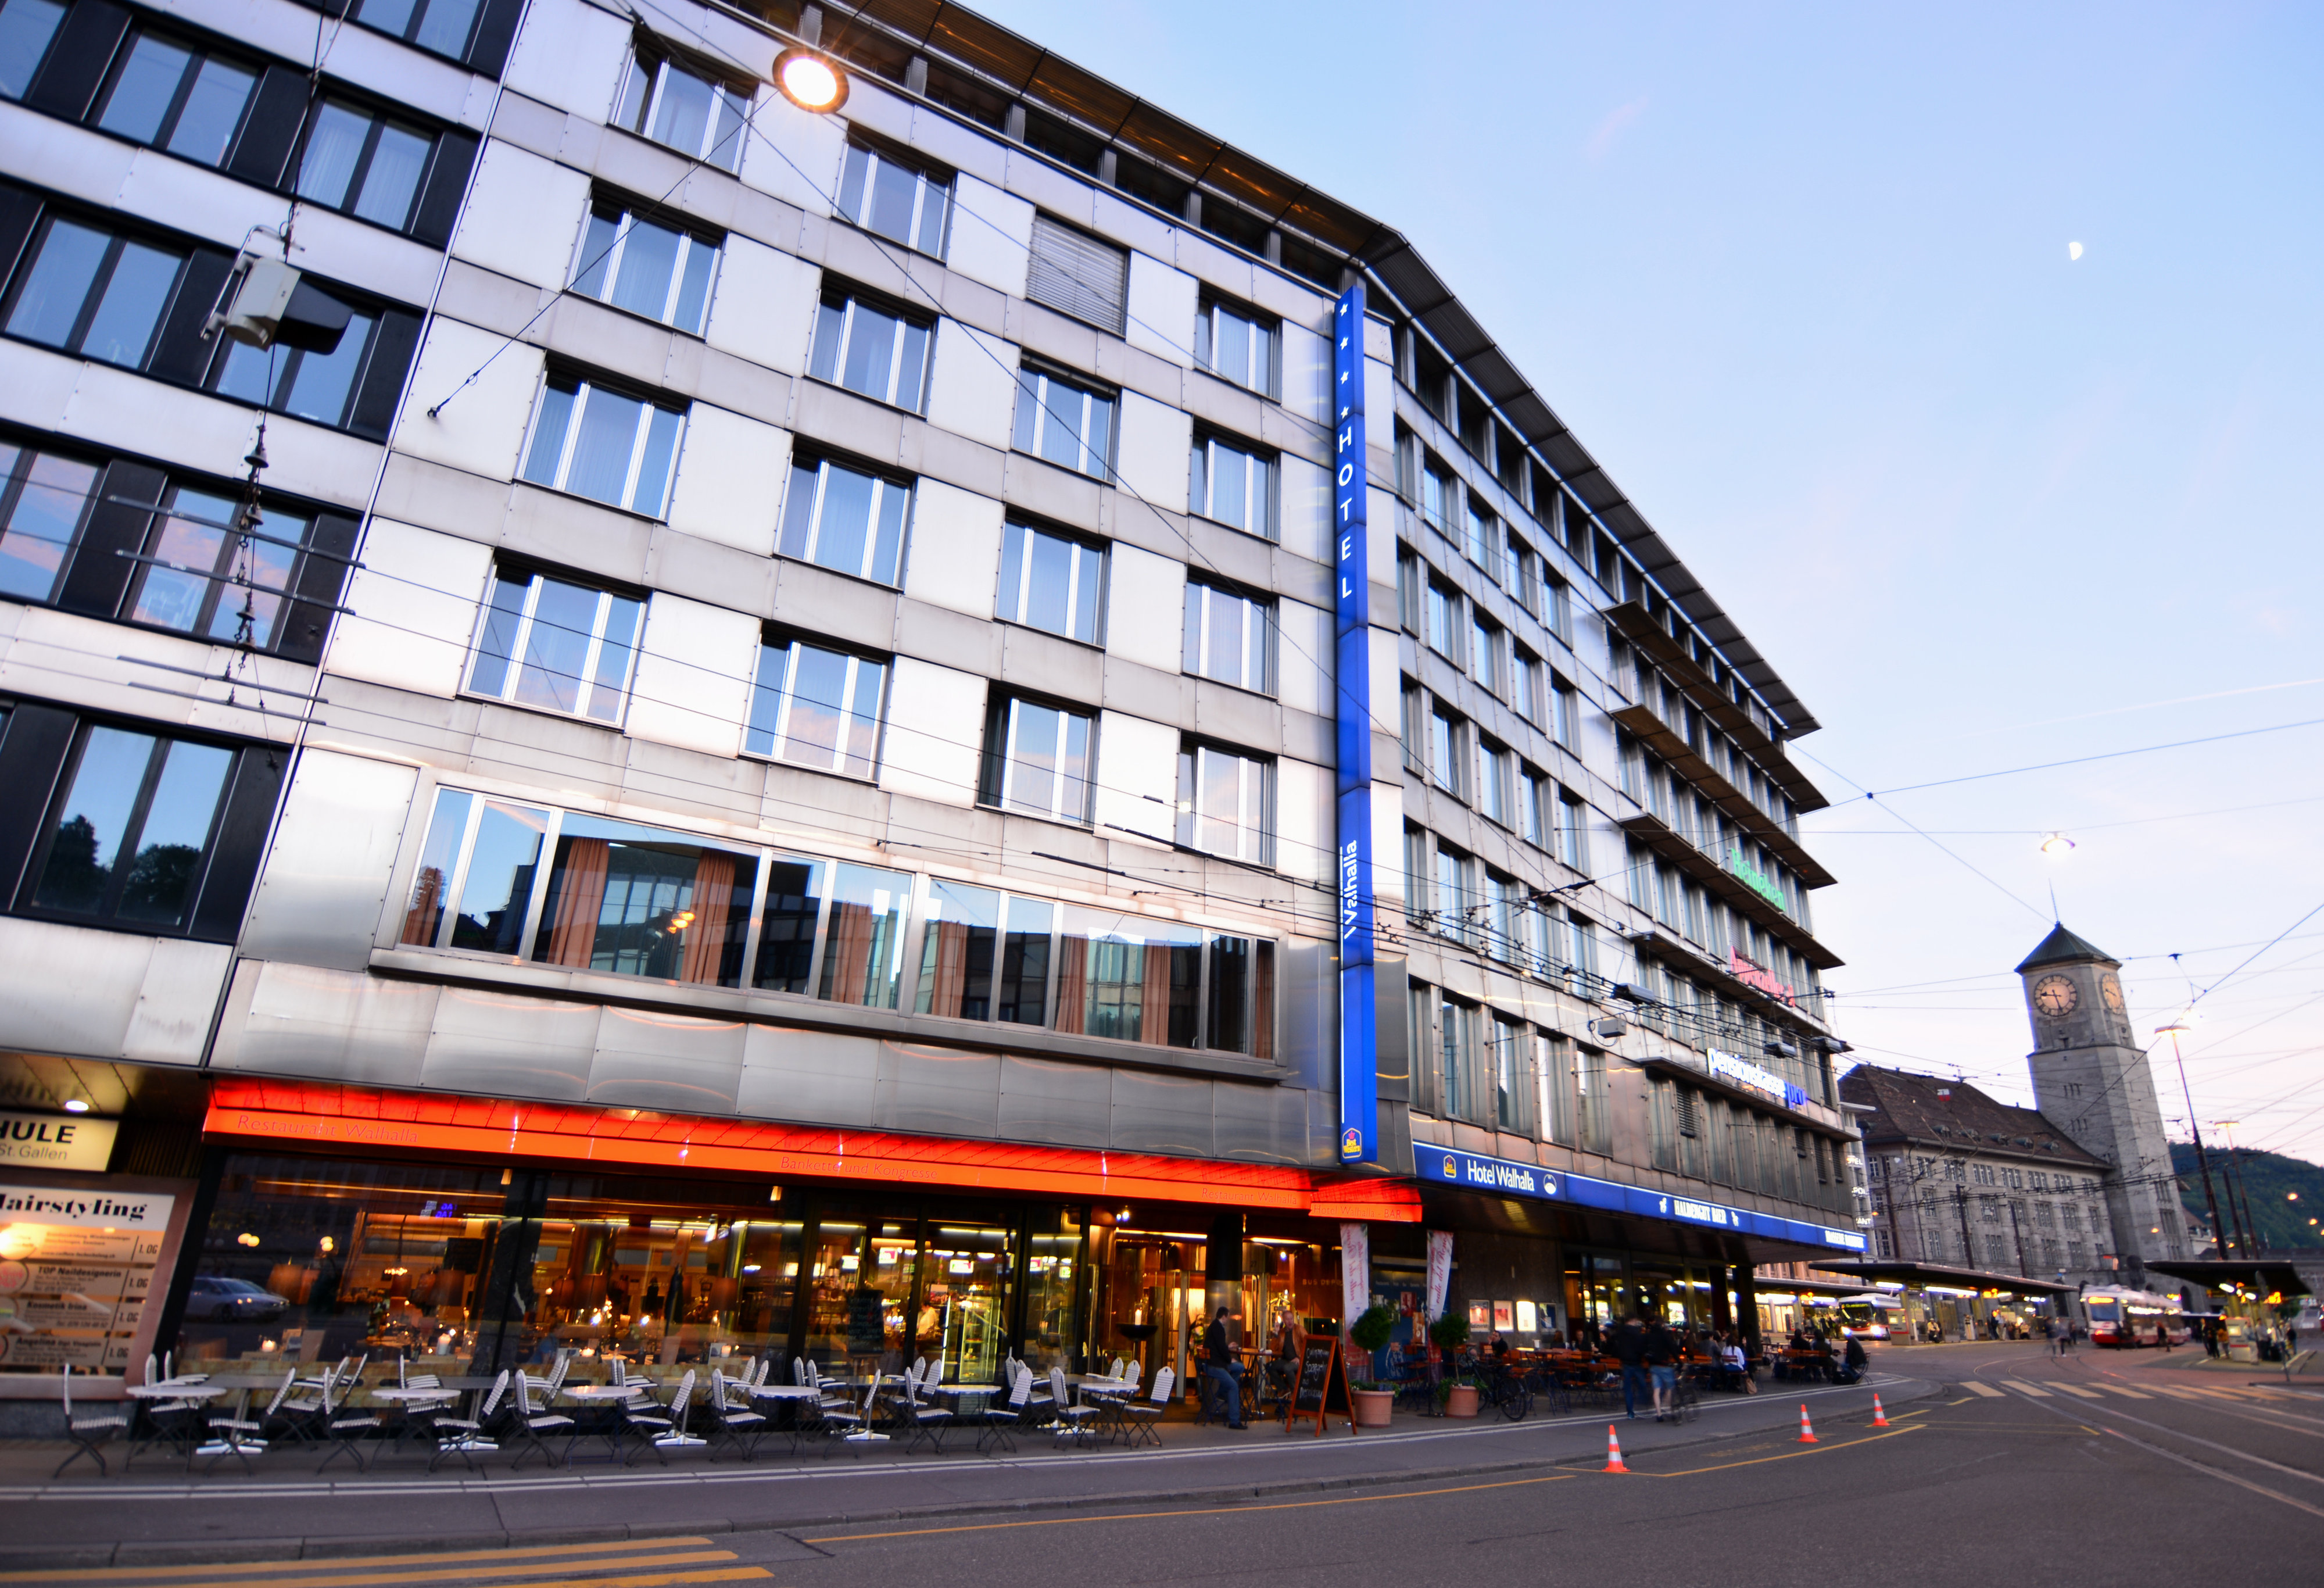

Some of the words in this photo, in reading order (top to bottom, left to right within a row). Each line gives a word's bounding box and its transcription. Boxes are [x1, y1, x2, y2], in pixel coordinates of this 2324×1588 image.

[1339, 425, 1352, 599] HOTEL
[1731, 848, 1785, 911] Heineken
[1344, 840, 1358, 939] Walhalla
[1707, 1048, 1786, 1098] pensionskasse
[1786, 1083, 1807, 1108] pro
[237, 1115, 337, 1137] Restaurant
[345, 1124, 418, 1143] Walhalla
[1344, 1145, 1361, 1153] Western
[1347, 1139, 1356, 1147] Best
[19, 1145, 67, 1160] Gallen
[781, 1157, 840, 1172] Bankette
[845, 1164, 868, 1174] und
[873, 1163, 937, 1181] Kongresse
[1467, 1159, 1495, 1185] Hotel
[1495, 1164, 1535, 1192] Walhalla
[1202, 1188, 1254, 1201] Restaurant
[1258, 1192, 1297, 1205] Walhalla
[1314, 1204, 1336, 1214] Hotel
[1341, 1206, 1374, 1218] Walhalla
[1384, 1209, 1402, 1219] BAR
[146, 1244, 158, 1254] OG
[38, 1266, 56, 1274] TOP
[137, 1278, 148, 1288] OG
[127, 1312, 139, 1322] OG
[117, 1348, 129, 1358] OG
